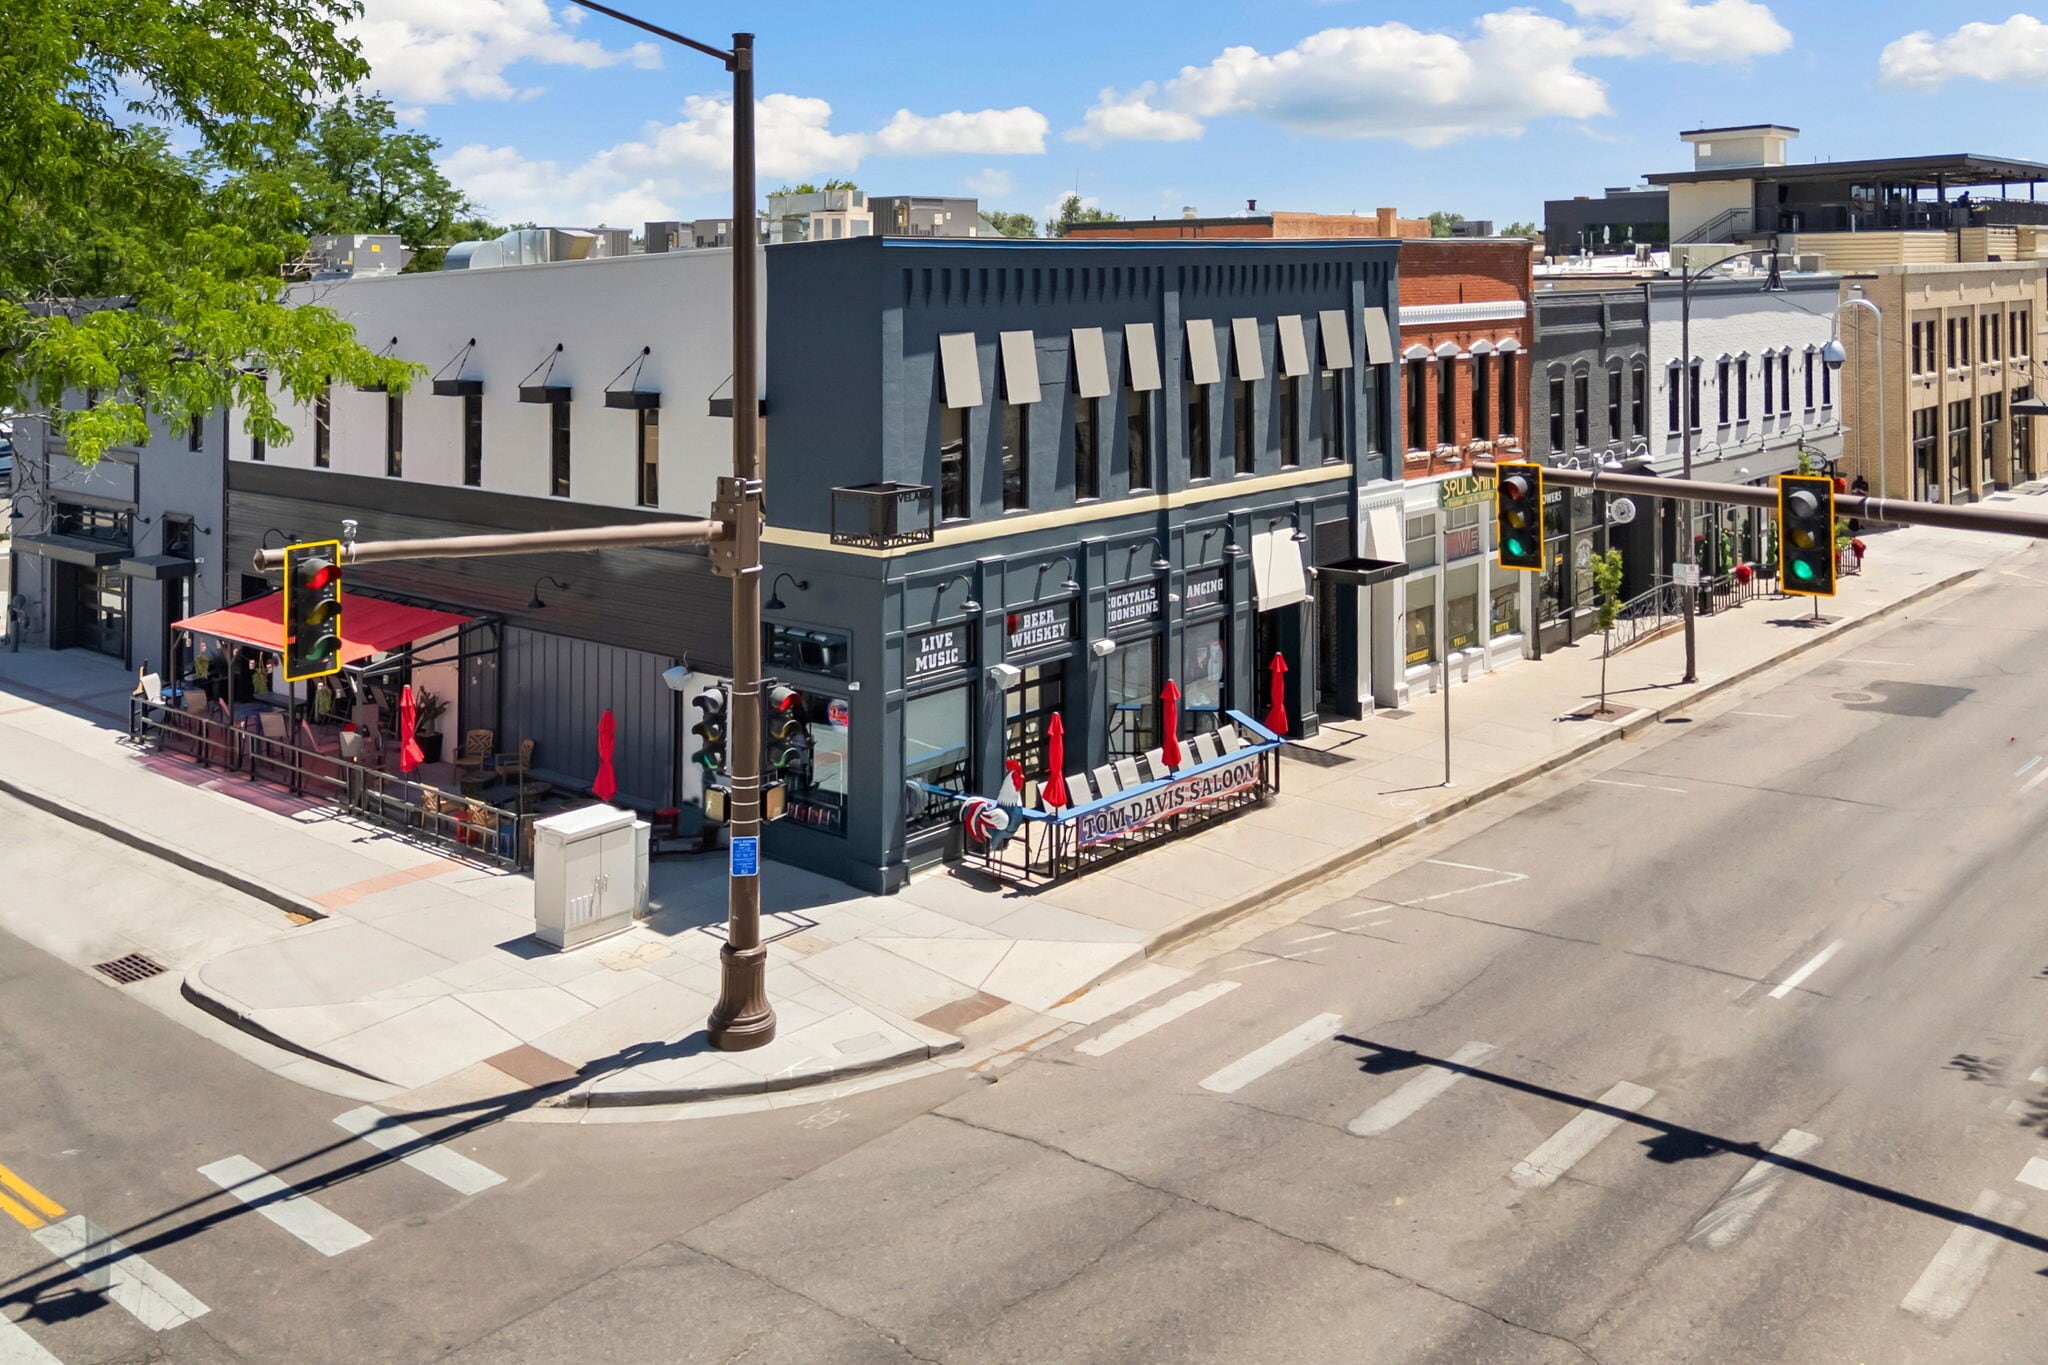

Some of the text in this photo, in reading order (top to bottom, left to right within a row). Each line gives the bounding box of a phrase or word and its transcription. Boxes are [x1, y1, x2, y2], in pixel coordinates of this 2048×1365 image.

[1443, 476, 1496, 500] SOUL SHIN
[1542, 490, 1562, 505] OWERS
[881, 530, 931, 547] STATION
[1186, 578, 1224, 599] ANCING
[1023, 609, 1055, 629] BEER
[921, 632, 953, 653] LIVE
[1011, 622, 1066, 648] WHISKEY
[915, 647, 959, 672] MUSIC
[1083, 760, 1256, 840] TOM DAVIS SALOON
